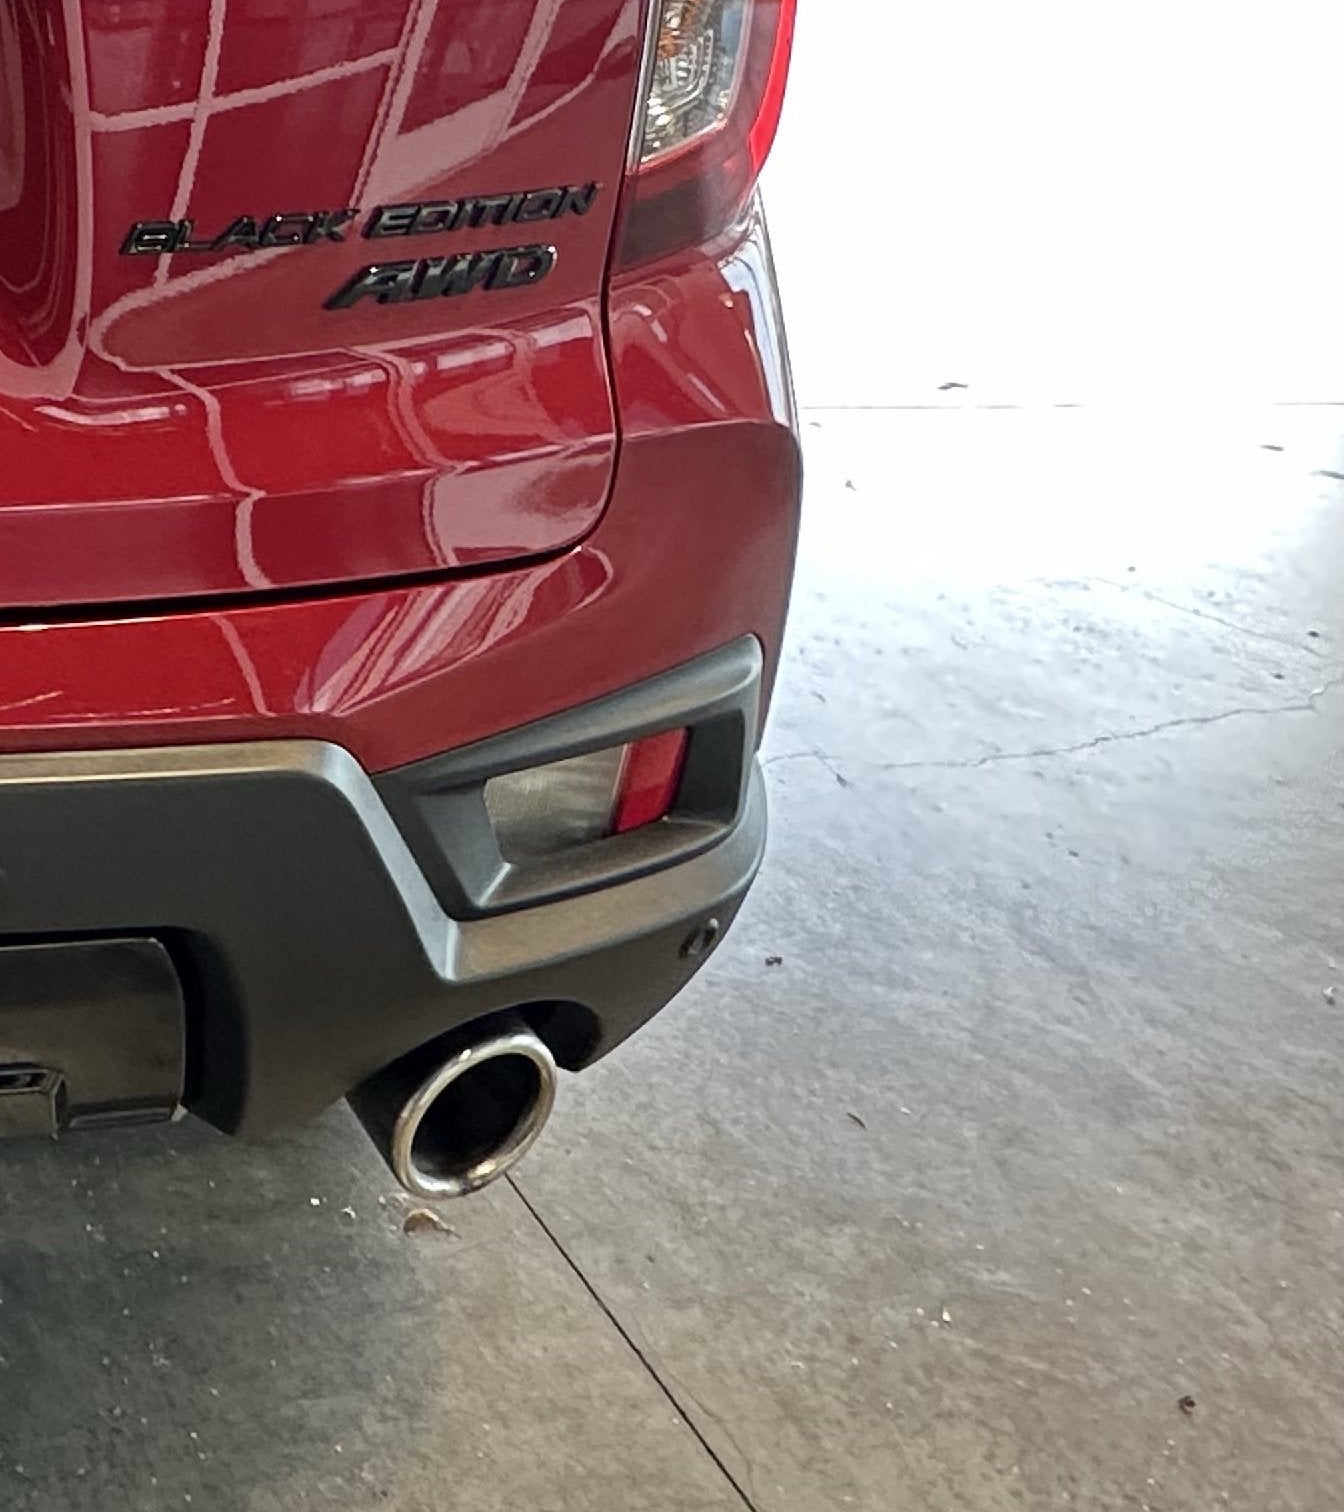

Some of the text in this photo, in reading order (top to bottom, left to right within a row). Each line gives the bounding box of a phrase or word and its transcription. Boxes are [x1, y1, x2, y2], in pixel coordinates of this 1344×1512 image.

[119, 182, 601, 255] BLACK EDITION
[322, 244, 559, 310] AWD
